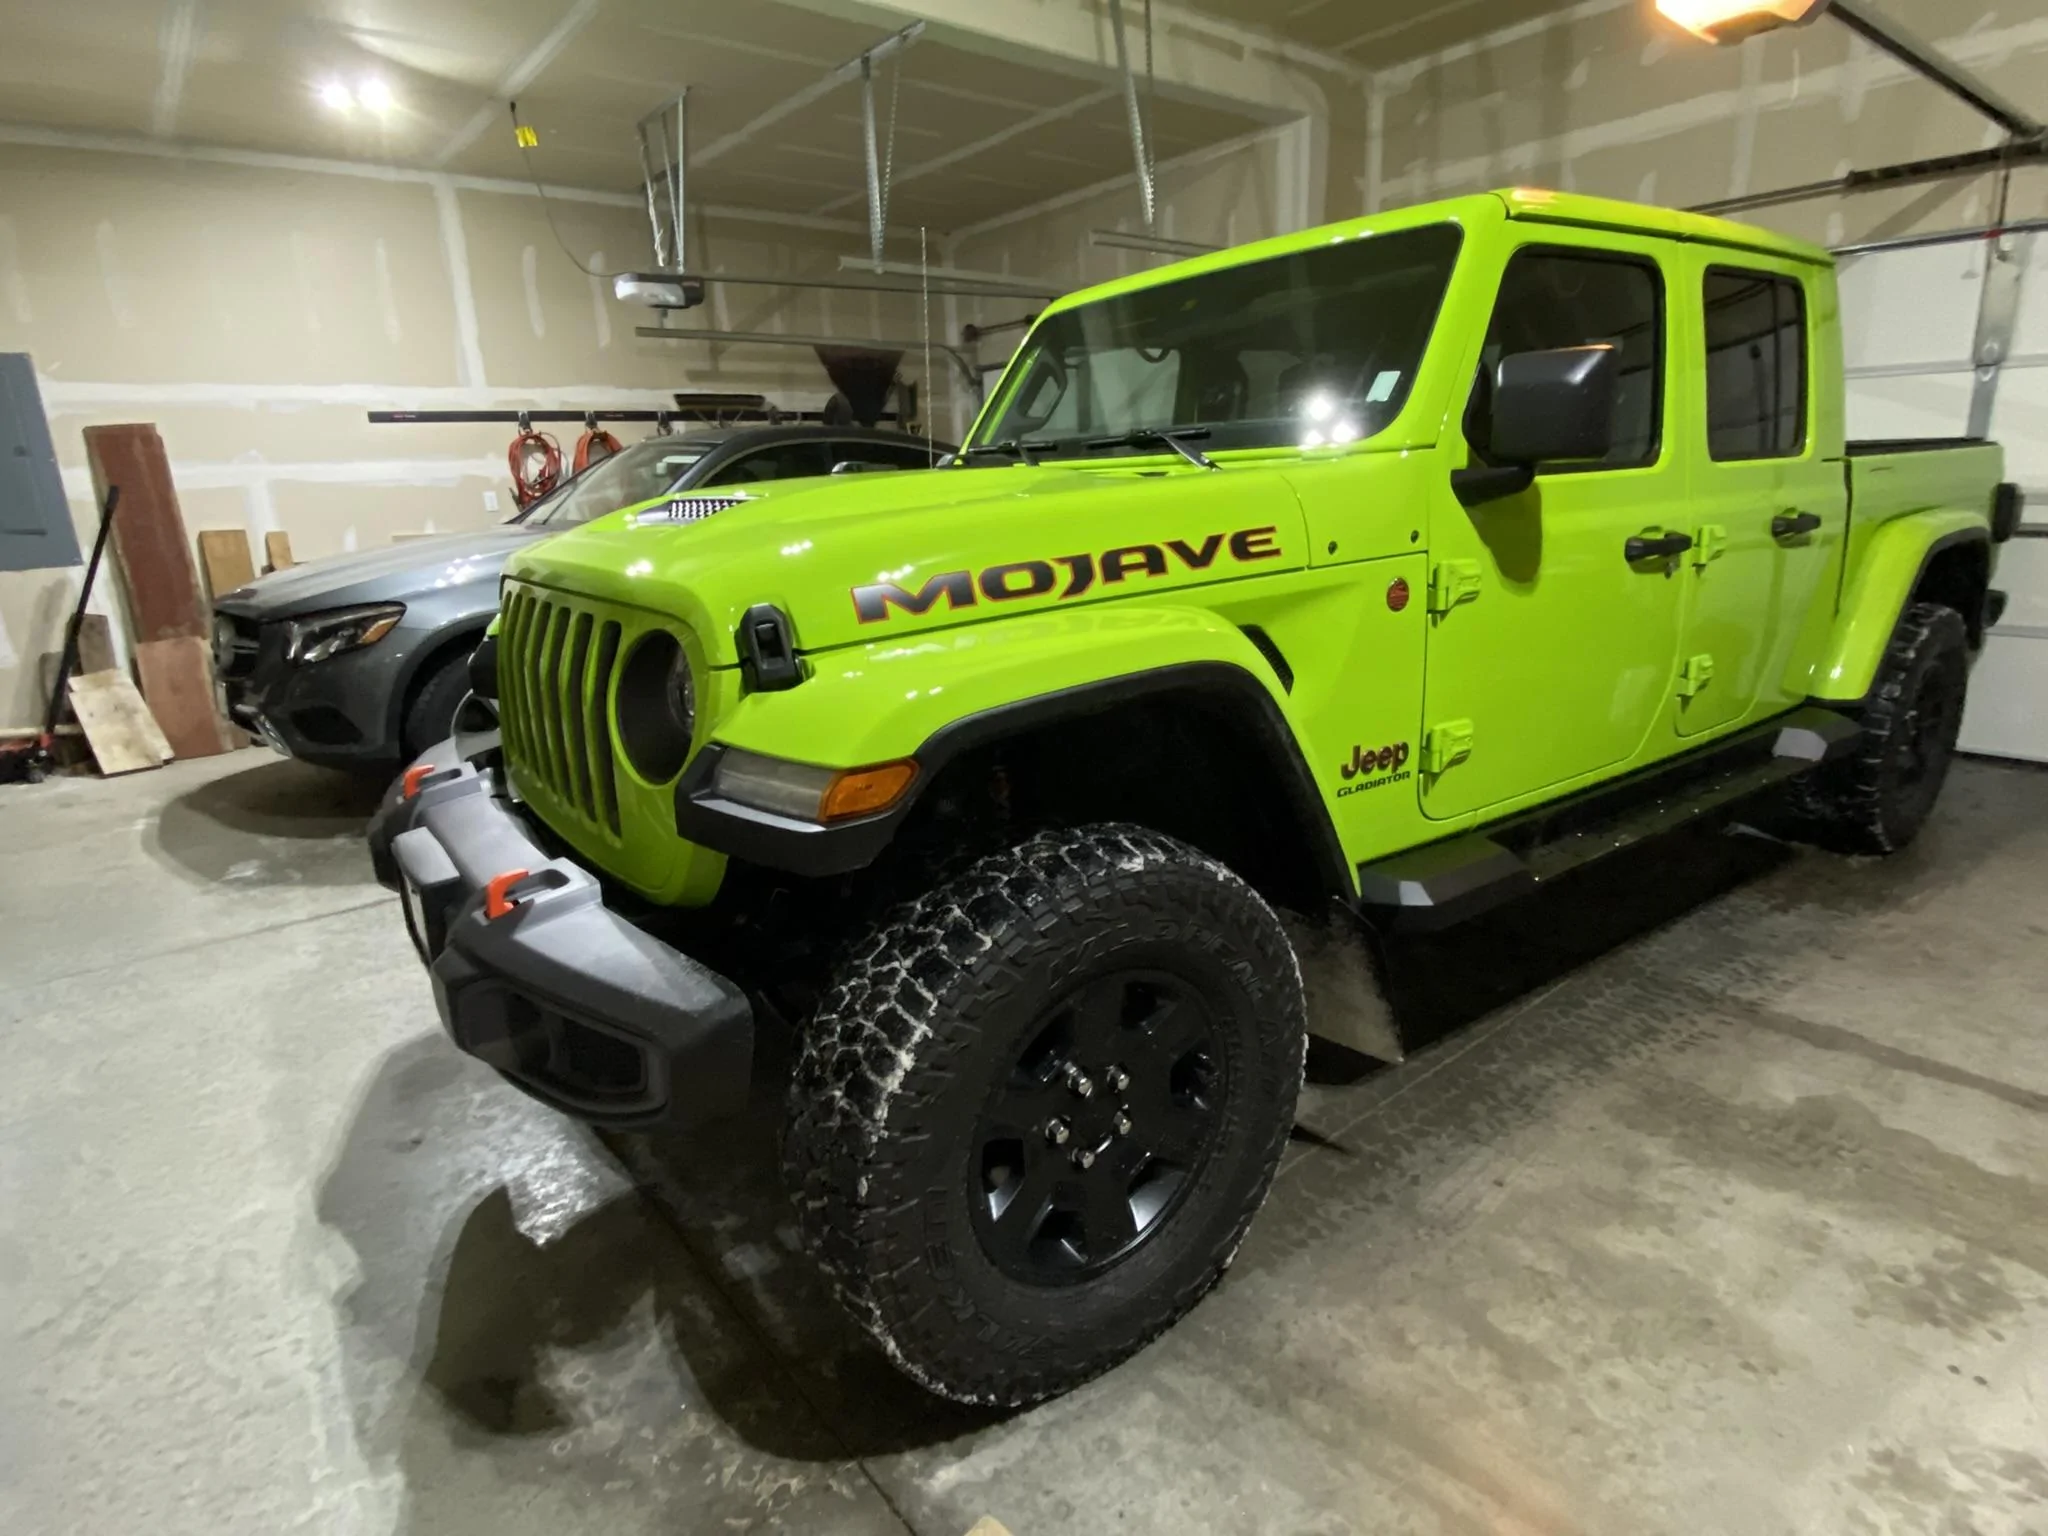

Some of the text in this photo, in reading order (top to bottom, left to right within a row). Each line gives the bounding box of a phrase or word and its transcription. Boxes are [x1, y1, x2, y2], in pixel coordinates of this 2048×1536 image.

[850, 526, 1282, 624] MOJAVE
[1341, 742, 1409, 780] Jeep
[1338, 771, 1410, 797] GLADIATOR
